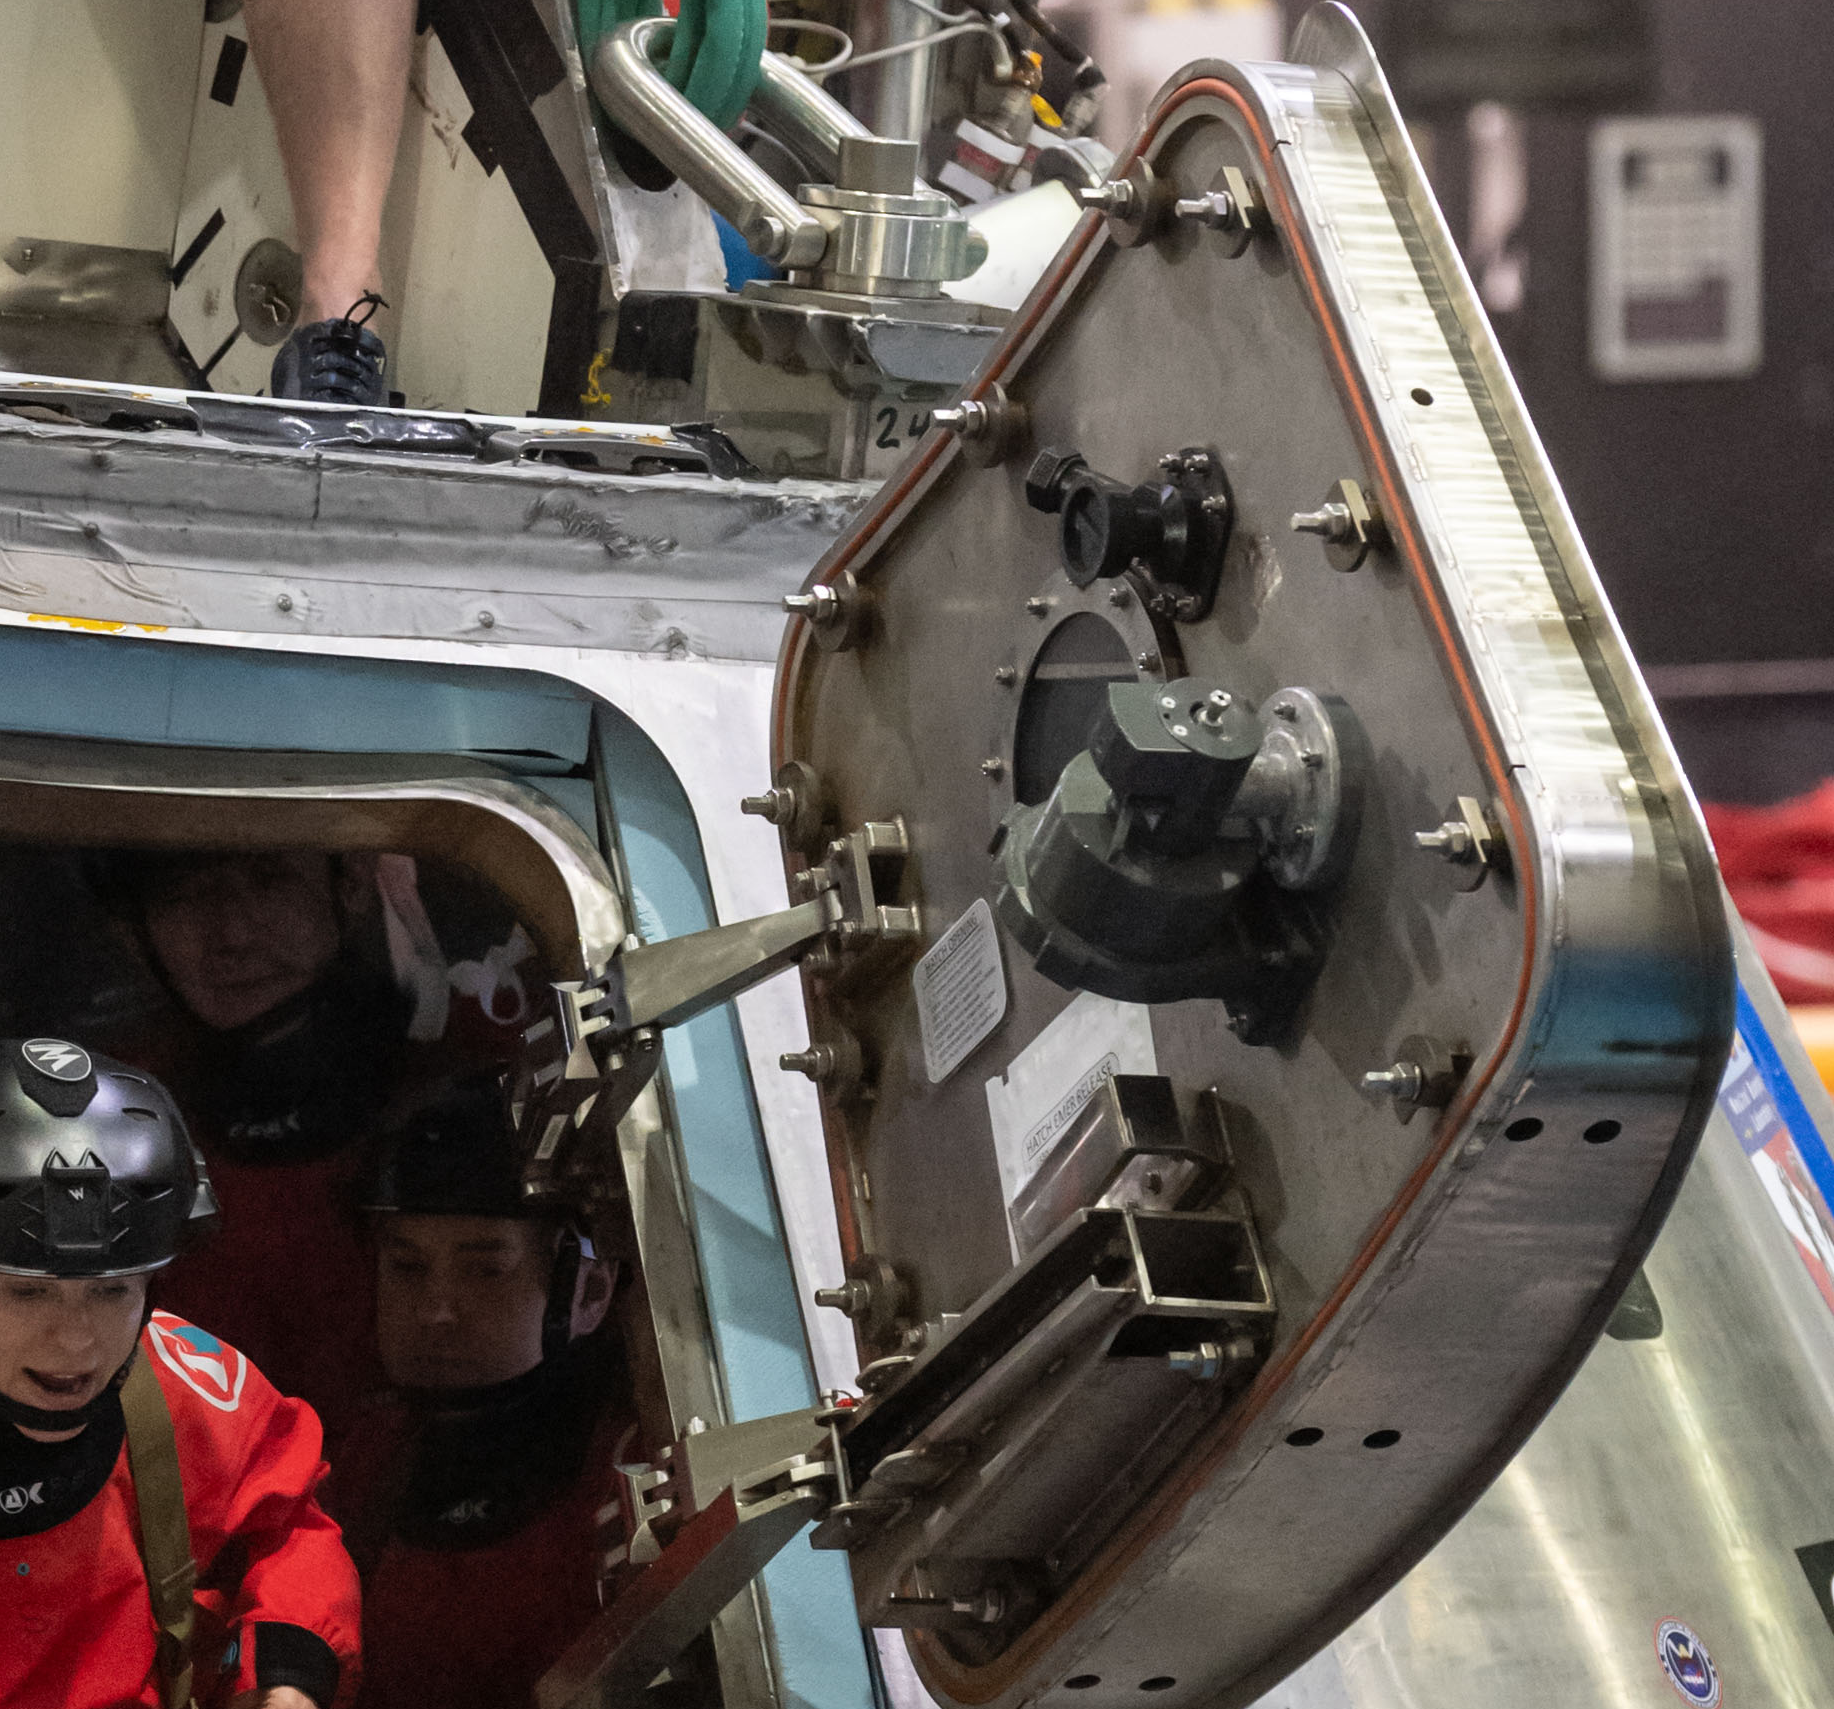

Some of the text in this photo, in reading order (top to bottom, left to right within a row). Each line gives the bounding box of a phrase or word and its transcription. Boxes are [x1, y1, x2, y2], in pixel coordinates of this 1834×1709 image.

[1026, 1060, 1113, 1157] HATCH EMER RELEASE
